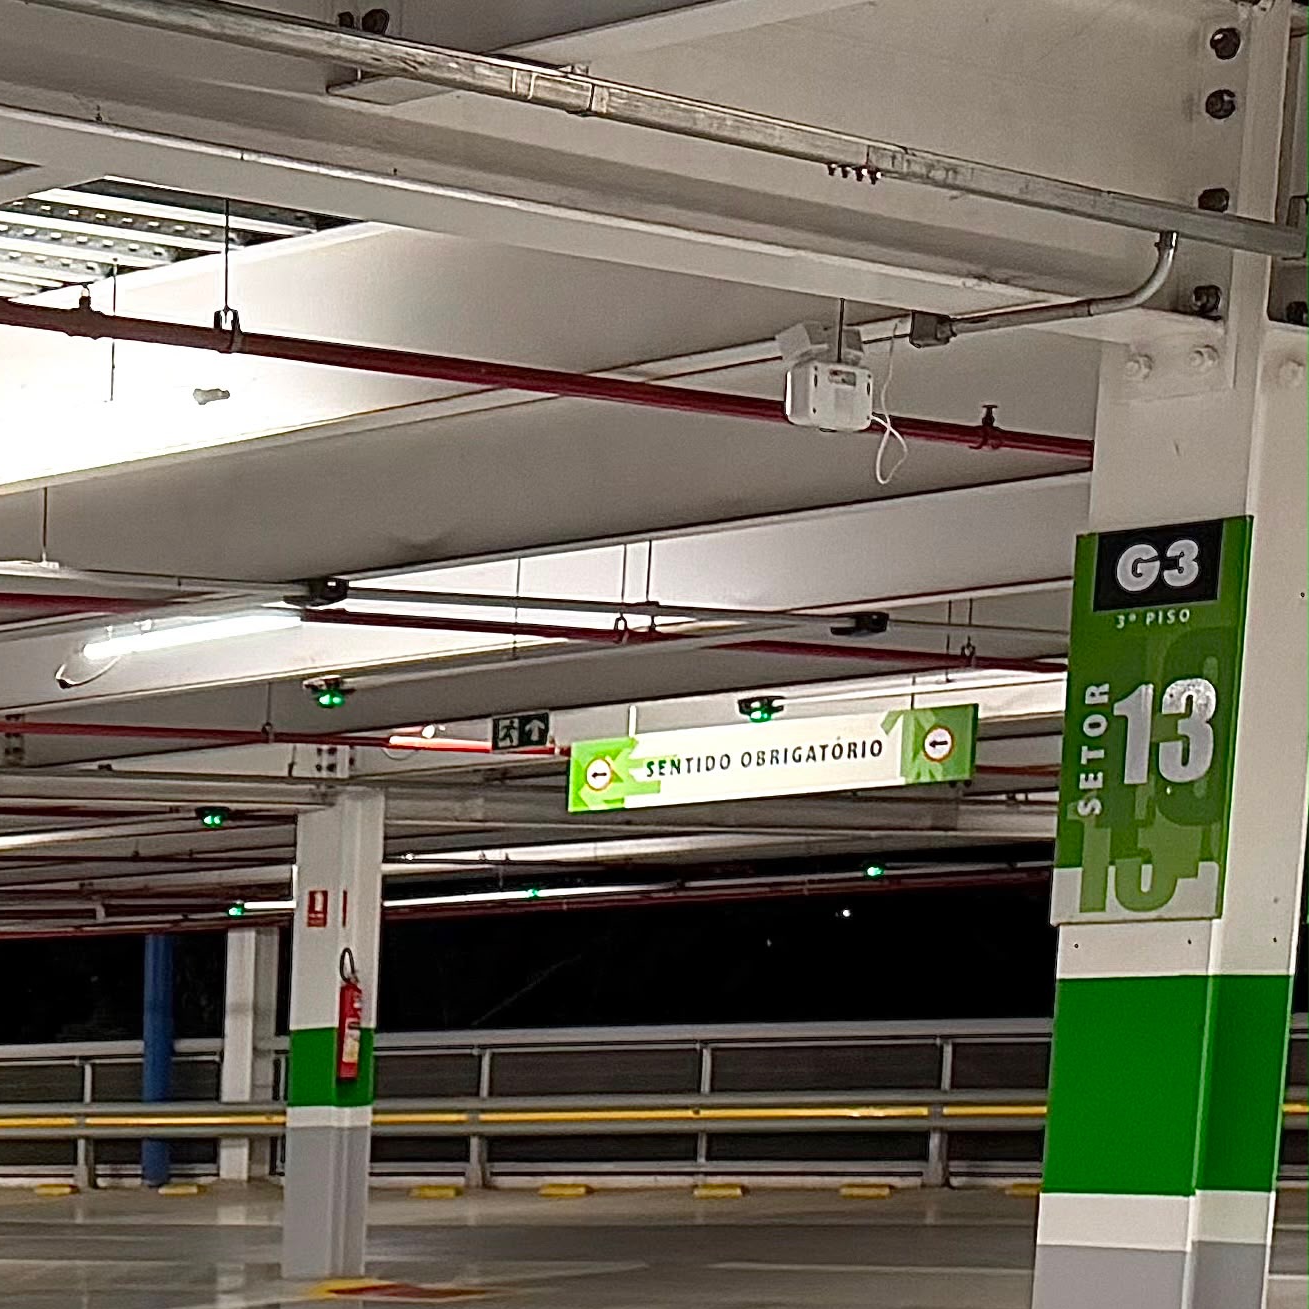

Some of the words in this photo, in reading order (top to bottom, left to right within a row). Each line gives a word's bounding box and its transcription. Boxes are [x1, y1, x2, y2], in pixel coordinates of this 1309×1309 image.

[1116, 539, 1201, 592] G3
[1146, 608, 1191, 626] PISO
[646, 751, 732, 779] SENTIDO
[740, 736, 883, 767] OBRIGATÓRIO
[1077, 682, 1110, 817] SETOR
[1113, 678, 1217, 786] 13
